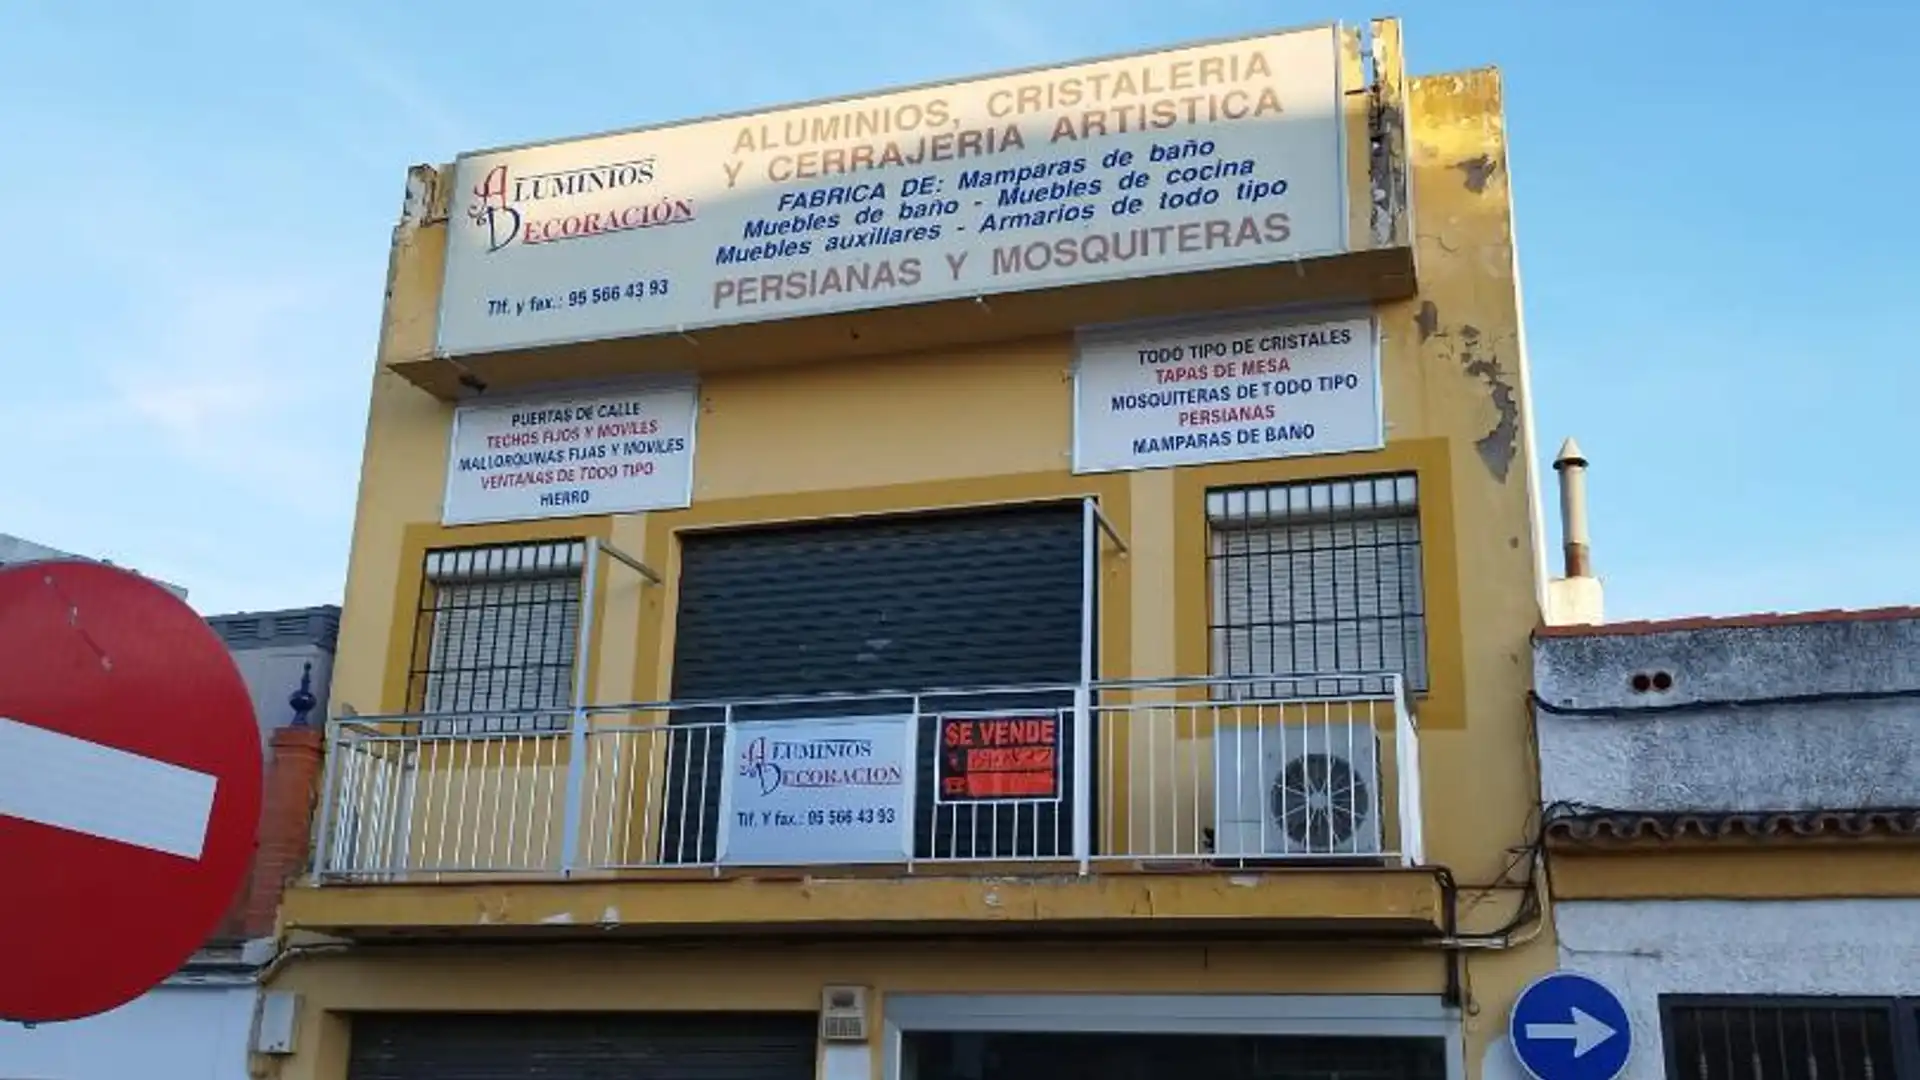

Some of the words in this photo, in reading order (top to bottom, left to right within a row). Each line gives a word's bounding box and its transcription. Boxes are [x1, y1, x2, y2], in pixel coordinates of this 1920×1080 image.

[733, 99, 960, 155] ALUMINIOS,
[986, 51, 1272, 118] CRISTALERIA
[723, 160, 744, 188] Y
[767, 122, 1025, 182] CERRAJERIA
[1050, 87, 1284, 143] ARTISTICA
[473, 160, 655, 208] ALUMINIOS
[777, 182, 886, 213] FABRICA
[900, 176, 945, 198] DE:
[957, 157, 1087, 190] Mamparas
[1102, 149, 1134, 168] de
[1149, 139, 1216, 163] baño
[743, 212, 840, 240] Muebles
[854, 206, 884, 226] de
[898, 199, 959, 220] baño
[997, 177, 1102, 208] Muebles
[1118, 170, 1150, 190] de
[1165, 158, 1255, 185] cocina
[715, 237, 812, 266] Muebles
[824, 223, 942, 252] auxiliares
[978, 201, 1095, 234] Armarios
[1111, 196, 1143, 217] de
[1158, 187, 1220, 210] todo
[1236, 179, 1289, 203] tipo
[713, 257, 923, 310] PERSIANAS
[945, 251, 969, 280] Y
[992, 212, 1292, 275] MOSQUITERAS
[516, 300, 525, 316] y
[569, 290, 587, 307] 95
[592, 286, 620, 303] 566
[624, 282, 644, 298] 43
[649, 279, 668, 295] 93
[1138, 347, 1184, 366] TODO
[1191, 341, 1227, 359] TIPO
[1232, 337, 1255, 354] DE
[1259, 328, 1352, 351] CRISTALES
[1156, 365, 1208, 385] TAPAS
[1213, 361, 1237, 377] DE
[1241, 357, 1290, 376] MESA
[1111, 385, 1231, 412] MOSQUITERAS
[1318, 374, 1358, 392] TIPO
[511, 408, 572, 428] PUERTAS
[576, 406, 594, 421] DE
[597, 402, 641, 419] CALLE
[1178, 404, 1276, 427] PERSIANAS
[487, 430, 540, 450] TECHOS
[542, 426, 580, 444] FIJOS
[584, 425, 594, 439] Y
[597, 419, 659, 439] MOVILES
[1132, 429, 1231, 454] MAMPARAS
[1236, 427, 1260, 445] DE
[459, 449, 565, 472] MALLORQUINAS
[568, 444, 606, 461] FIJAS
[611, 442, 620, 456] Y
[623, 437, 685, 456] MOVILES
[480, 468, 554, 490] VENTANAS
[556, 466, 575, 483] DE
[580, 464, 618, 481] TODO
[622, 461, 654, 478] TIPO
[540, 489, 590, 507] HIERRO
[945, 721, 974, 747] SE
[979, 719, 1056, 745] VENDE
[829, 810, 853, 825] 566
[857, 809, 873, 823] 43
[877, 808, 895, 823] 93
